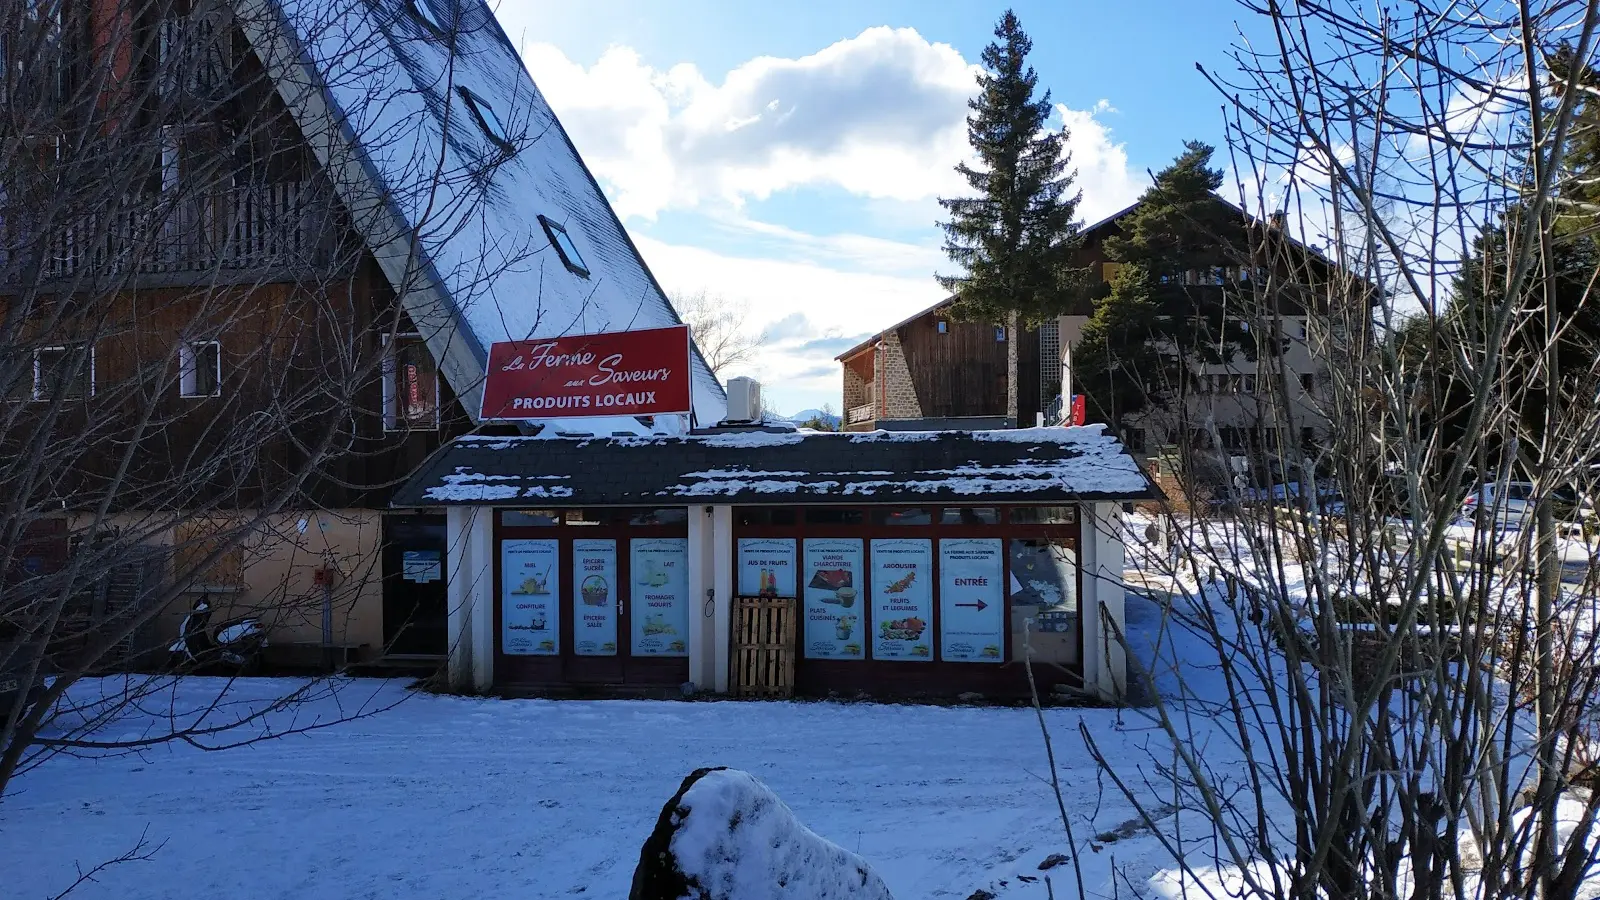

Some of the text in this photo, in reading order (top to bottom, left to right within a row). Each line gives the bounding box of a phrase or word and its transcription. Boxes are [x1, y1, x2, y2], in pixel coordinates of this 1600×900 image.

[502, 341, 596, 371] La Ferme
[563, 353, 671, 387] aux Saveurs
[513, 391, 656, 410] PRODUITS LOCAUX
[954, 576, 988, 586] ENTRÉE
